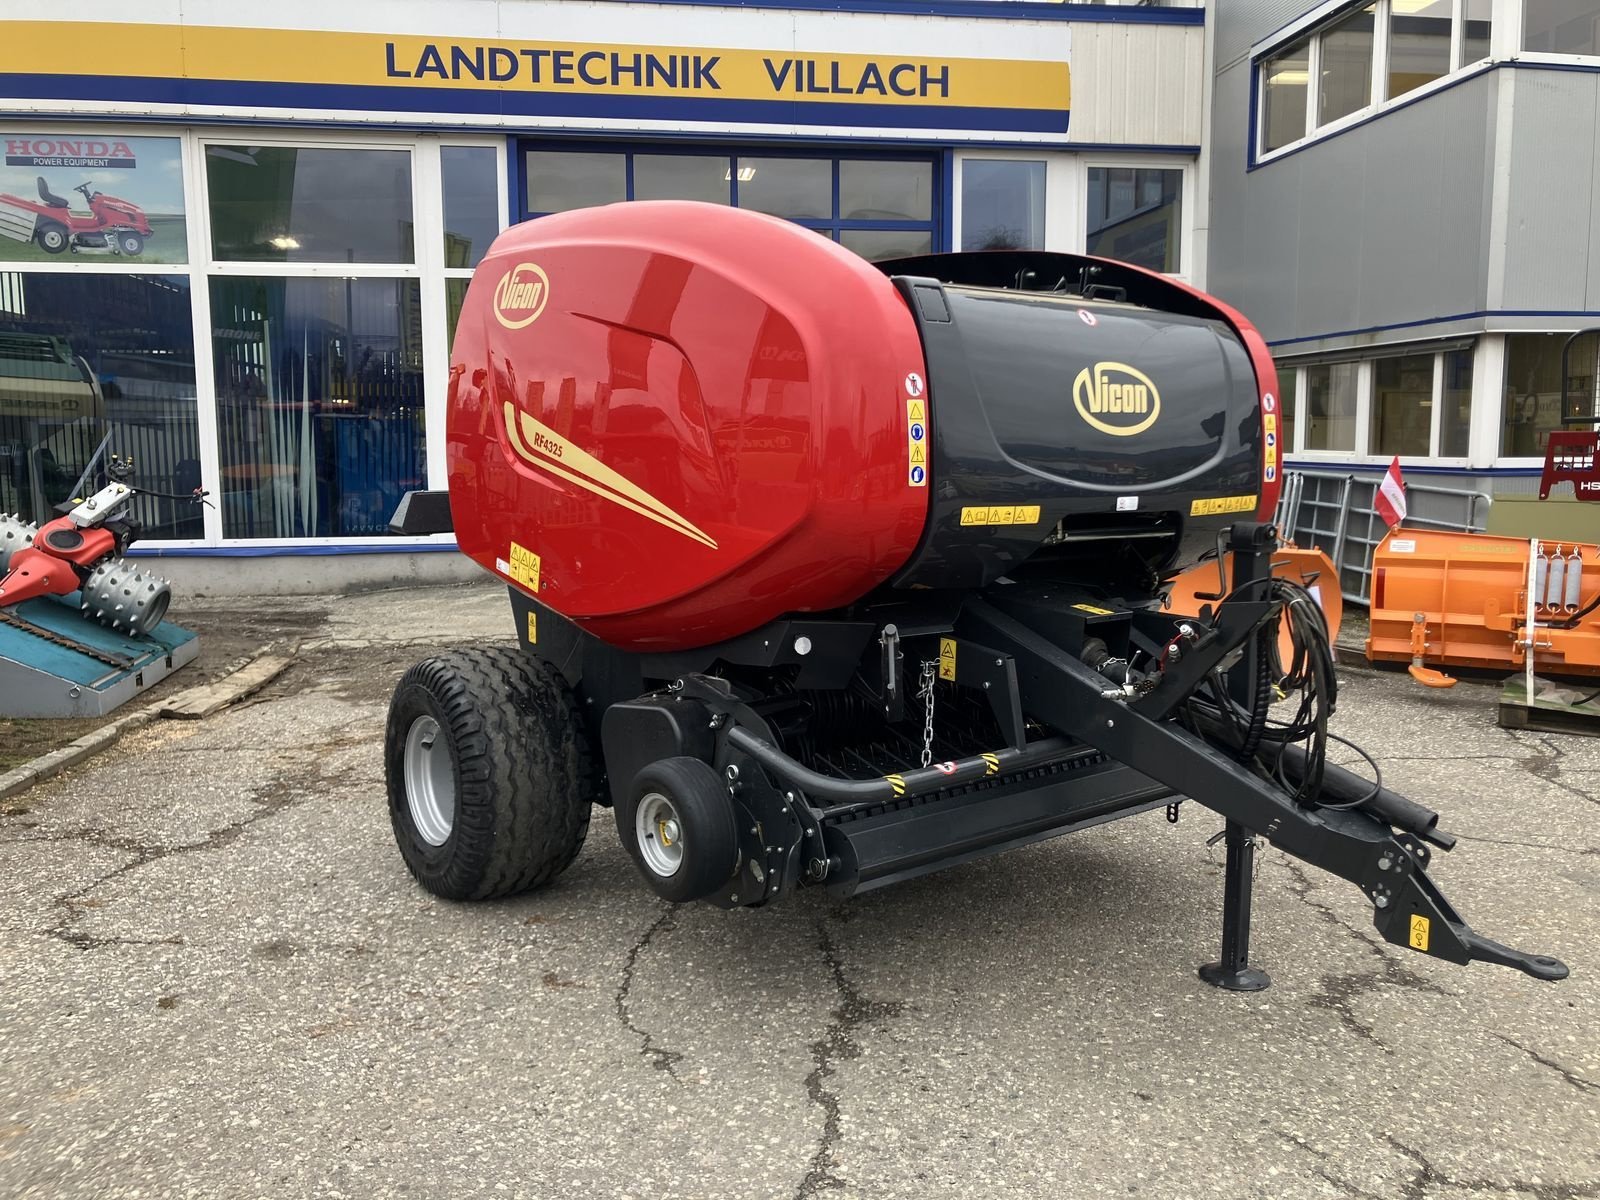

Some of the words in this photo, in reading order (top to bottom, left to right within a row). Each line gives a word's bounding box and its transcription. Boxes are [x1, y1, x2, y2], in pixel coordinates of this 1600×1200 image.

[385, 42, 722, 89] LANDTECHNIK
[762, 58, 949, 98] VILLACH
[5, 140, 136, 158] HONDA
[33, 158, 63, 166] POWER
[63, 159, 109, 167] EQUIPMENT
[498, 263, 543, 310] Vicon
[1079, 362, 1149, 414] Vicon
[534, 431, 563, 458] RF4325
